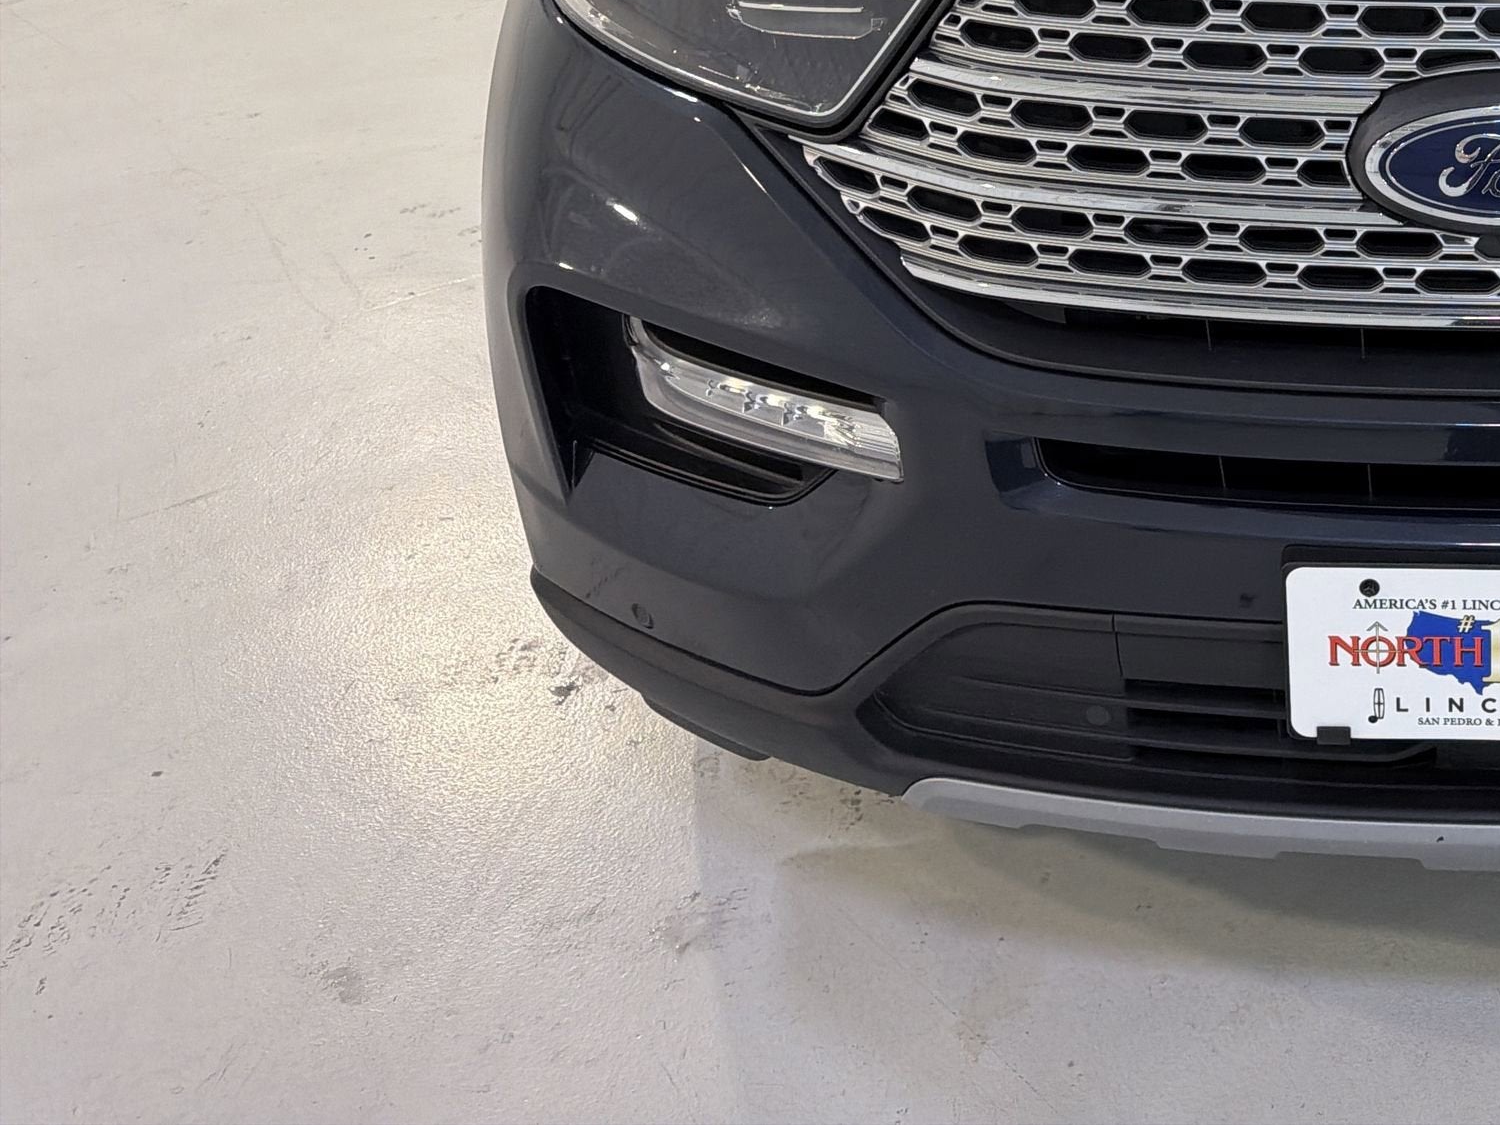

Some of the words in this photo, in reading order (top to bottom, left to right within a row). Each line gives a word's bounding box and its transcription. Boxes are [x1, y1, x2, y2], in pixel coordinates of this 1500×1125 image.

[1352, 597, 1438, 612] AMERICA'S
[1440, 599, 1458, 612] #1
[1328, 634, 1484, 669] NORTH
[1417, 717, 1441, 727] SAN
[1443, 717, 1482, 727] PEDRO
[1484, 718, 1495, 727] &
